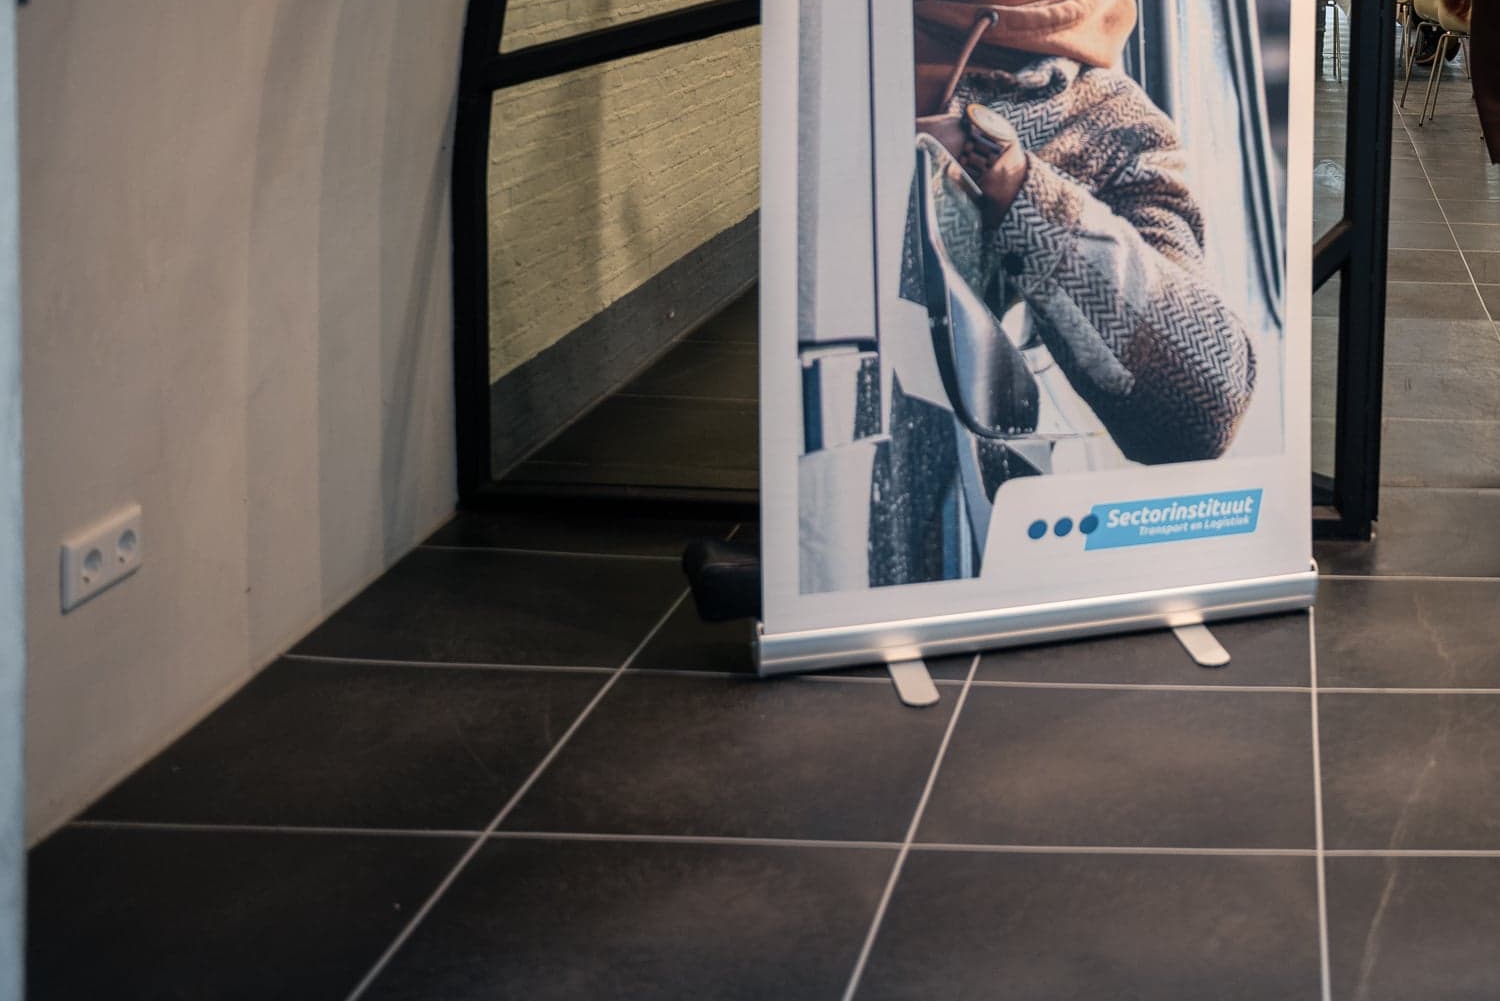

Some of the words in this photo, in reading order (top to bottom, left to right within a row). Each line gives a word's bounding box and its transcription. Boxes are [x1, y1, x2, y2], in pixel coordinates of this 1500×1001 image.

[1106, 495, 1254, 528] Sectorinstituut
[1139, 521, 1188, 536] Transport
[1190, 521, 1203, 531] en
[1204, 515, 1249, 530] Logistiek
